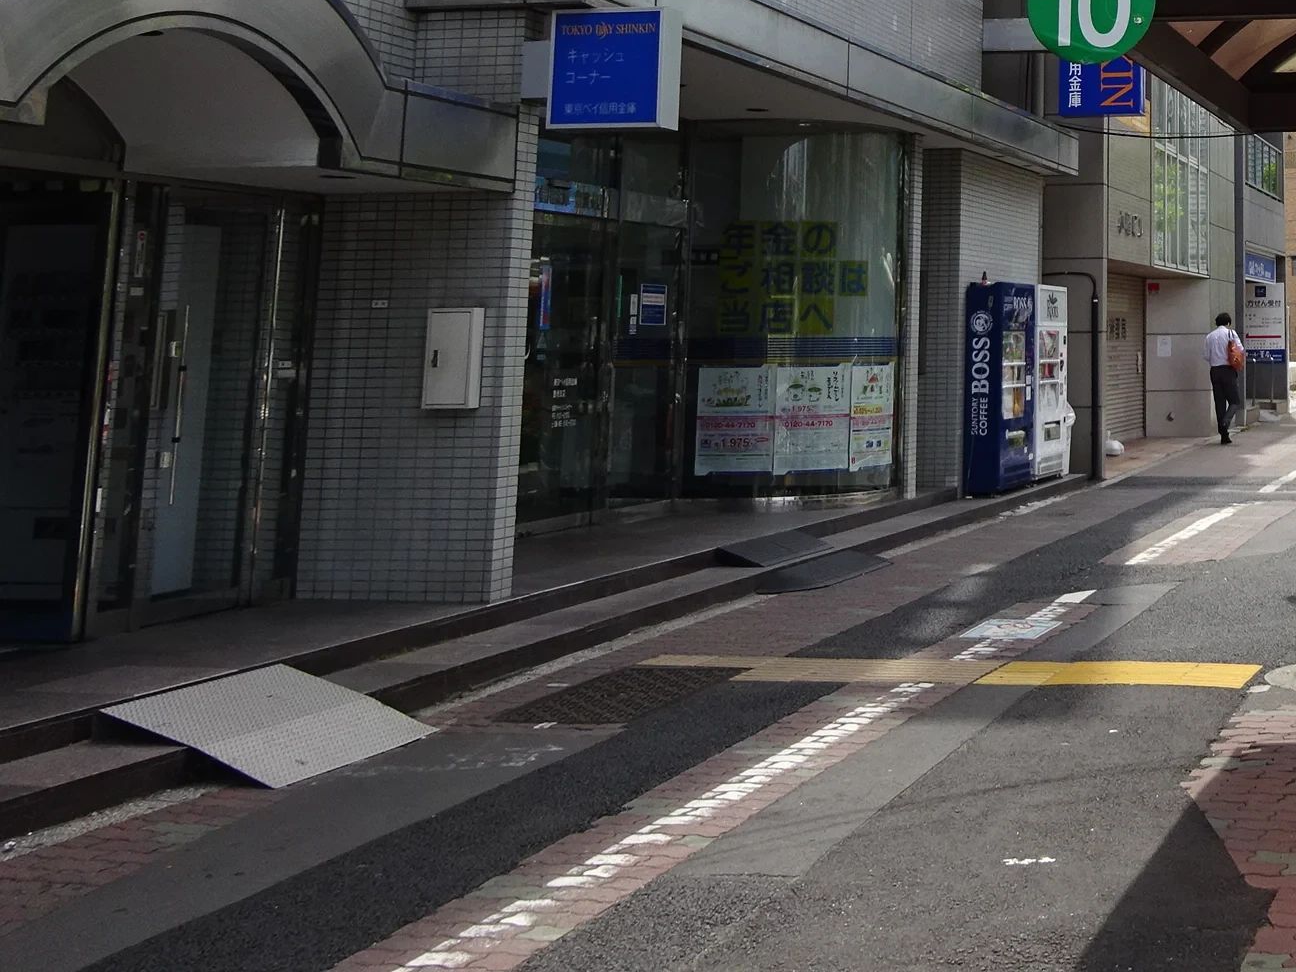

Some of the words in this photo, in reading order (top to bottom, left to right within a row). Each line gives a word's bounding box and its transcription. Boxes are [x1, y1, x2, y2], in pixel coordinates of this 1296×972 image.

[561, 24, 592, 36] TOKYO
[616, 22, 656, 35] SHINKIN
[567, 47, 625, 64] キャッシュ
[564, 69, 611, 85] コーナー
[721, 222, 836, 257] 年金の
[720, 260, 866, 294] ご相談は
[720, 299, 833, 335] 当店へ
[971, 336, 991, 395] BOSS
[971, 398, 979, 435] SUNTORY
[979, 398, 989, 436] COFFEE
